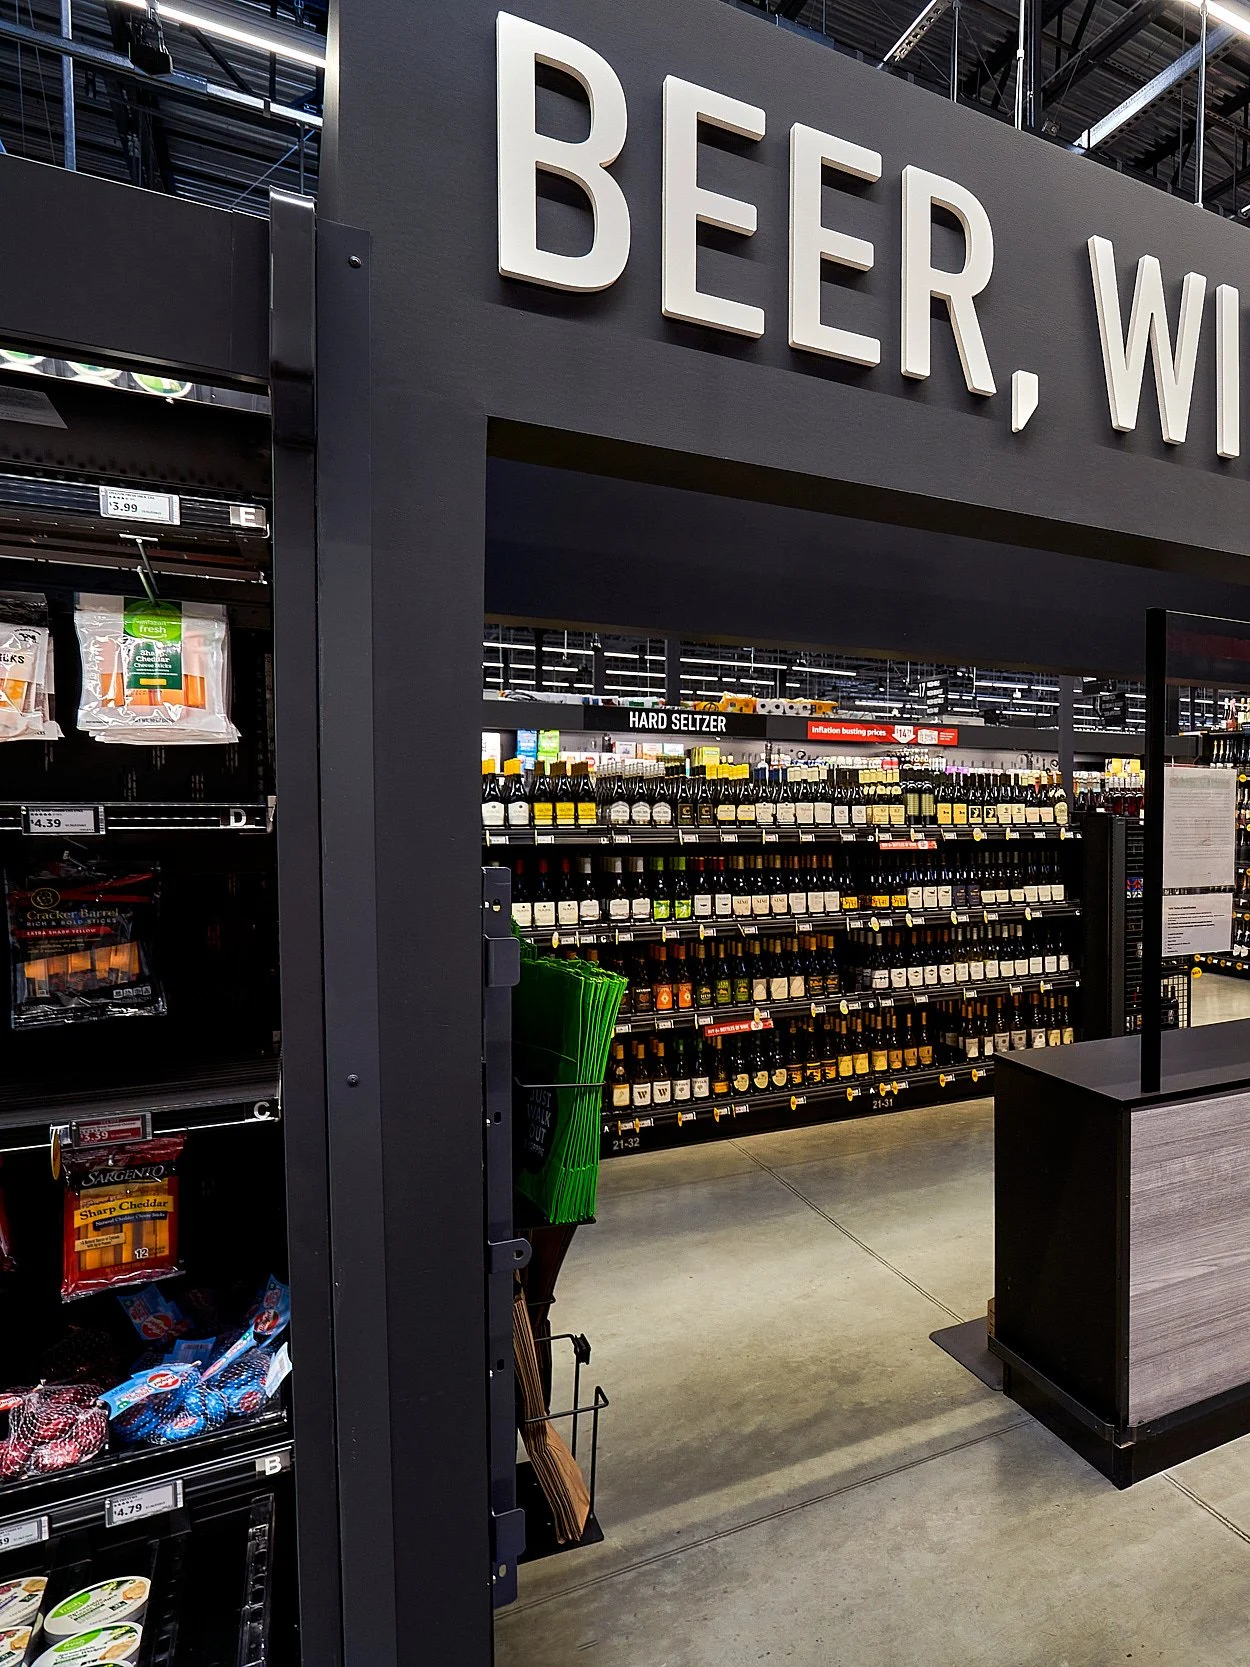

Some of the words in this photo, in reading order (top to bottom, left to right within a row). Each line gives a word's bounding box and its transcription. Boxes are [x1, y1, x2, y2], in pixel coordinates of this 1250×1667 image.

[496, 11, 1039, 433] BEER,
[239, 507, 256, 527] E
[139, 625, 166, 634] fresh
[629, 711, 667, 730] HARD
[671, 714, 727, 732] SELTZER
[811, 726, 840, 735] Inflation
[841, 728, 867, 737] busting
[867, 729, 887, 737] prices
[229, 808, 247, 827] D
[26, 910, 76, 920] Cracker
[80, 908, 119, 918] Barrel
[529, 1088, 551, 1108] JUST
[872, 1099, 893, 1109] 21-31
[253, 1101, 271, 1120] C
[612, 1137, 640, 1150] 21-32
[82, 1165, 165, 1187] SARGENTO
[79, 1206, 117, 1221] Sharp
[119, 1198, 169, 1211] Cheddar
[135, 1247, 149, 1260] 12
[264, 1455, 282, 1475] B
